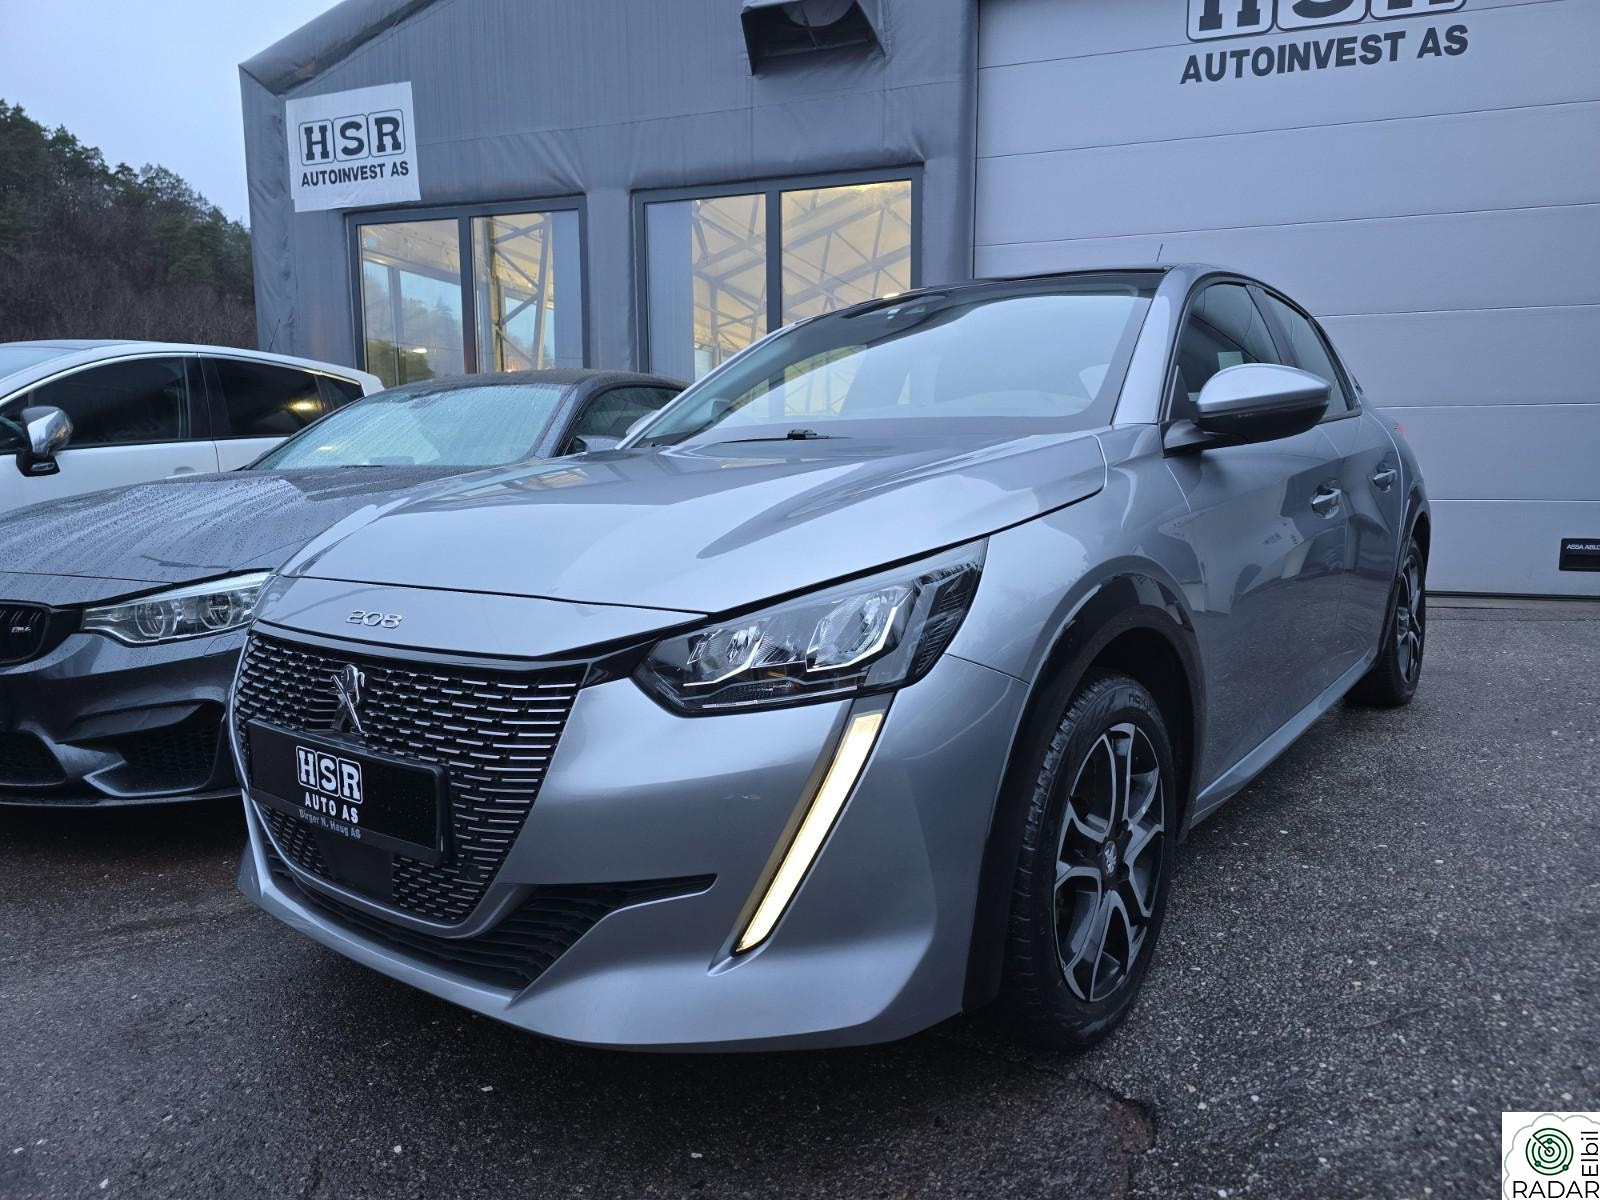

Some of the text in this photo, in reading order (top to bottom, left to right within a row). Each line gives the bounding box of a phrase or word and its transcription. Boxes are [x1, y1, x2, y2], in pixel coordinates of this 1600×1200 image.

[1180, 24, 1469, 84] AUTOINVEST AS
[304, 116, 402, 161] HSR
[301, 160, 409, 187] AUTOINVEST AS
[346, 610, 402, 629] 208
[298, 750, 361, 801] HSR
[304, 792, 359, 824] AUTO AS
[320, 817, 329, 828] N.
[330, 820, 349, 837] Haug
[350, 827, 361, 839] AS
